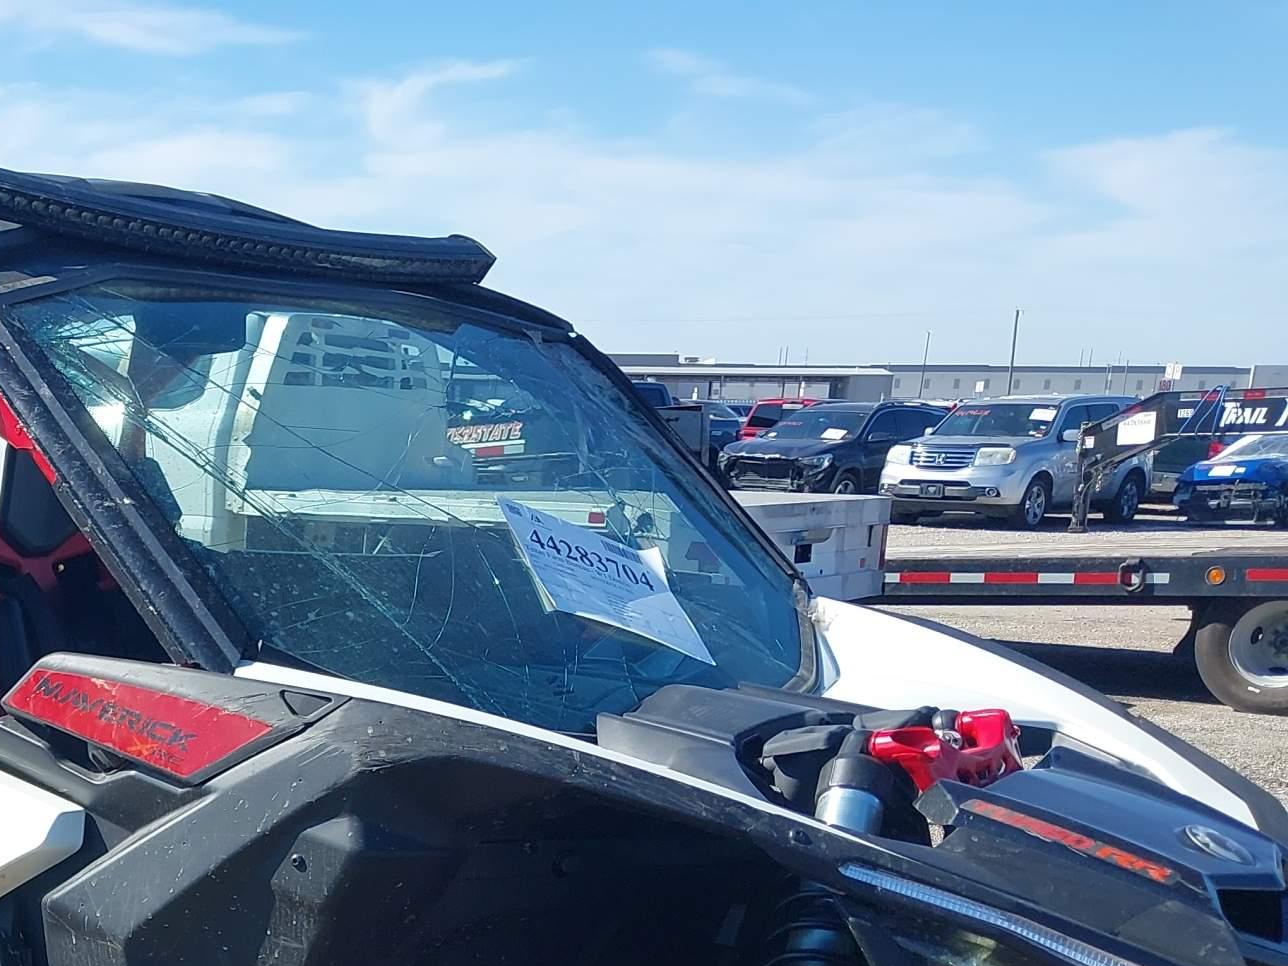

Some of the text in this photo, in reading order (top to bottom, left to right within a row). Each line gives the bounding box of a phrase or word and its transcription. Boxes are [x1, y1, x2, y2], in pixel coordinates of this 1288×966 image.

[1219, 402, 1268, 427] TRAIL
[529, 529, 655, 592] 44283704
[32, 674, 199, 752] MAVERICK
